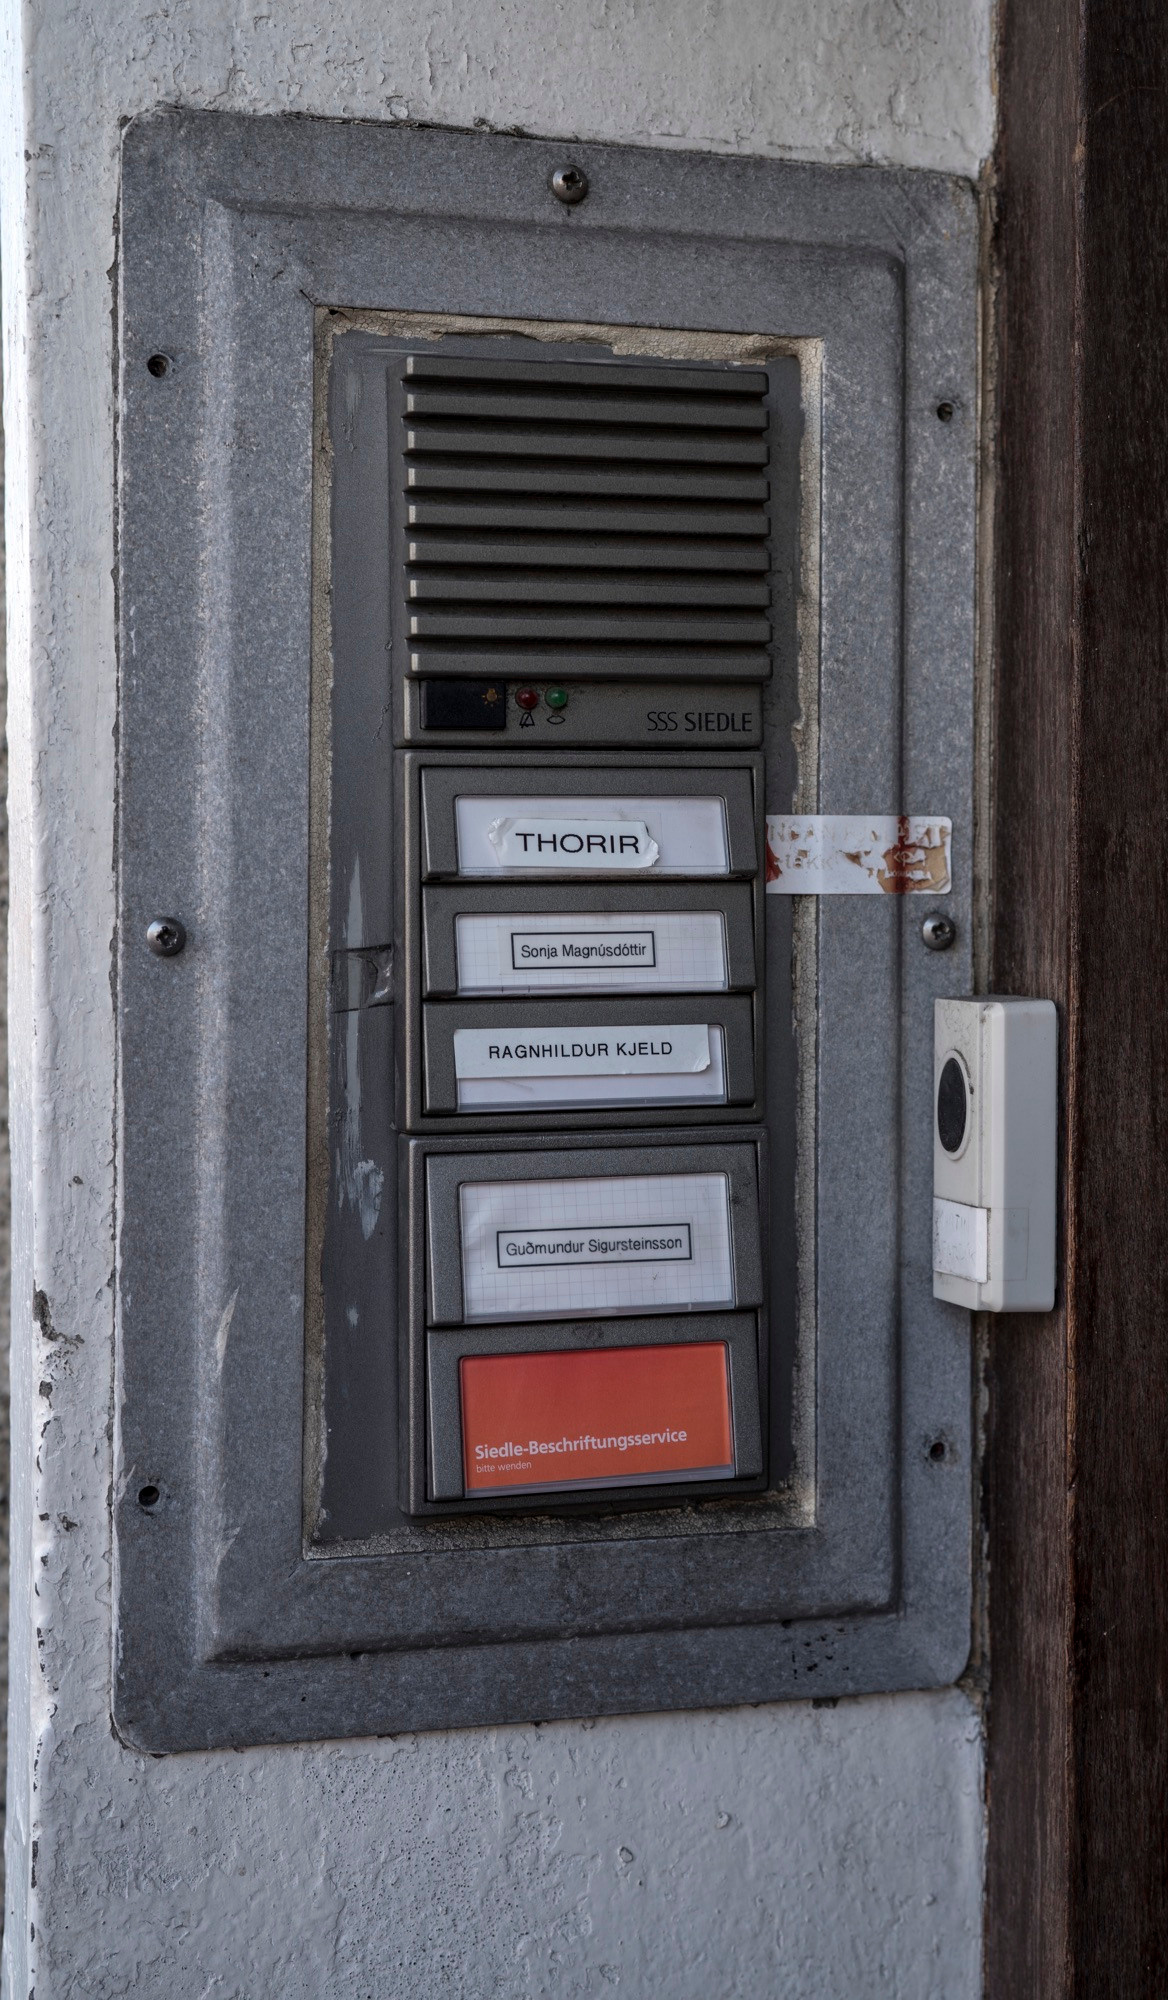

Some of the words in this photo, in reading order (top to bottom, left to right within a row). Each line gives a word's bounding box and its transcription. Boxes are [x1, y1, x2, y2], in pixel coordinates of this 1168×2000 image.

[685, 712, 753, 732] SIEDLE
[515, 833, 640, 854] THORIR
[520, 944, 559, 960] Sonja
[562, 942, 646, 959] Magnúsdóttir
[489, 1043, 609, 1060] RAGNHILDUR
[616, 1041, 673, 1057] KJELD
[506, 1240, 585, 1257] Guðmundur
[588, 1236, 683, 1254] Sigursteinsson
[475, 1428, 688, 1460] Siedle-Beschriftungsservice
[476, 1464, 496, 1474] bitte
[497, 1460, 532, 1472] wenden
